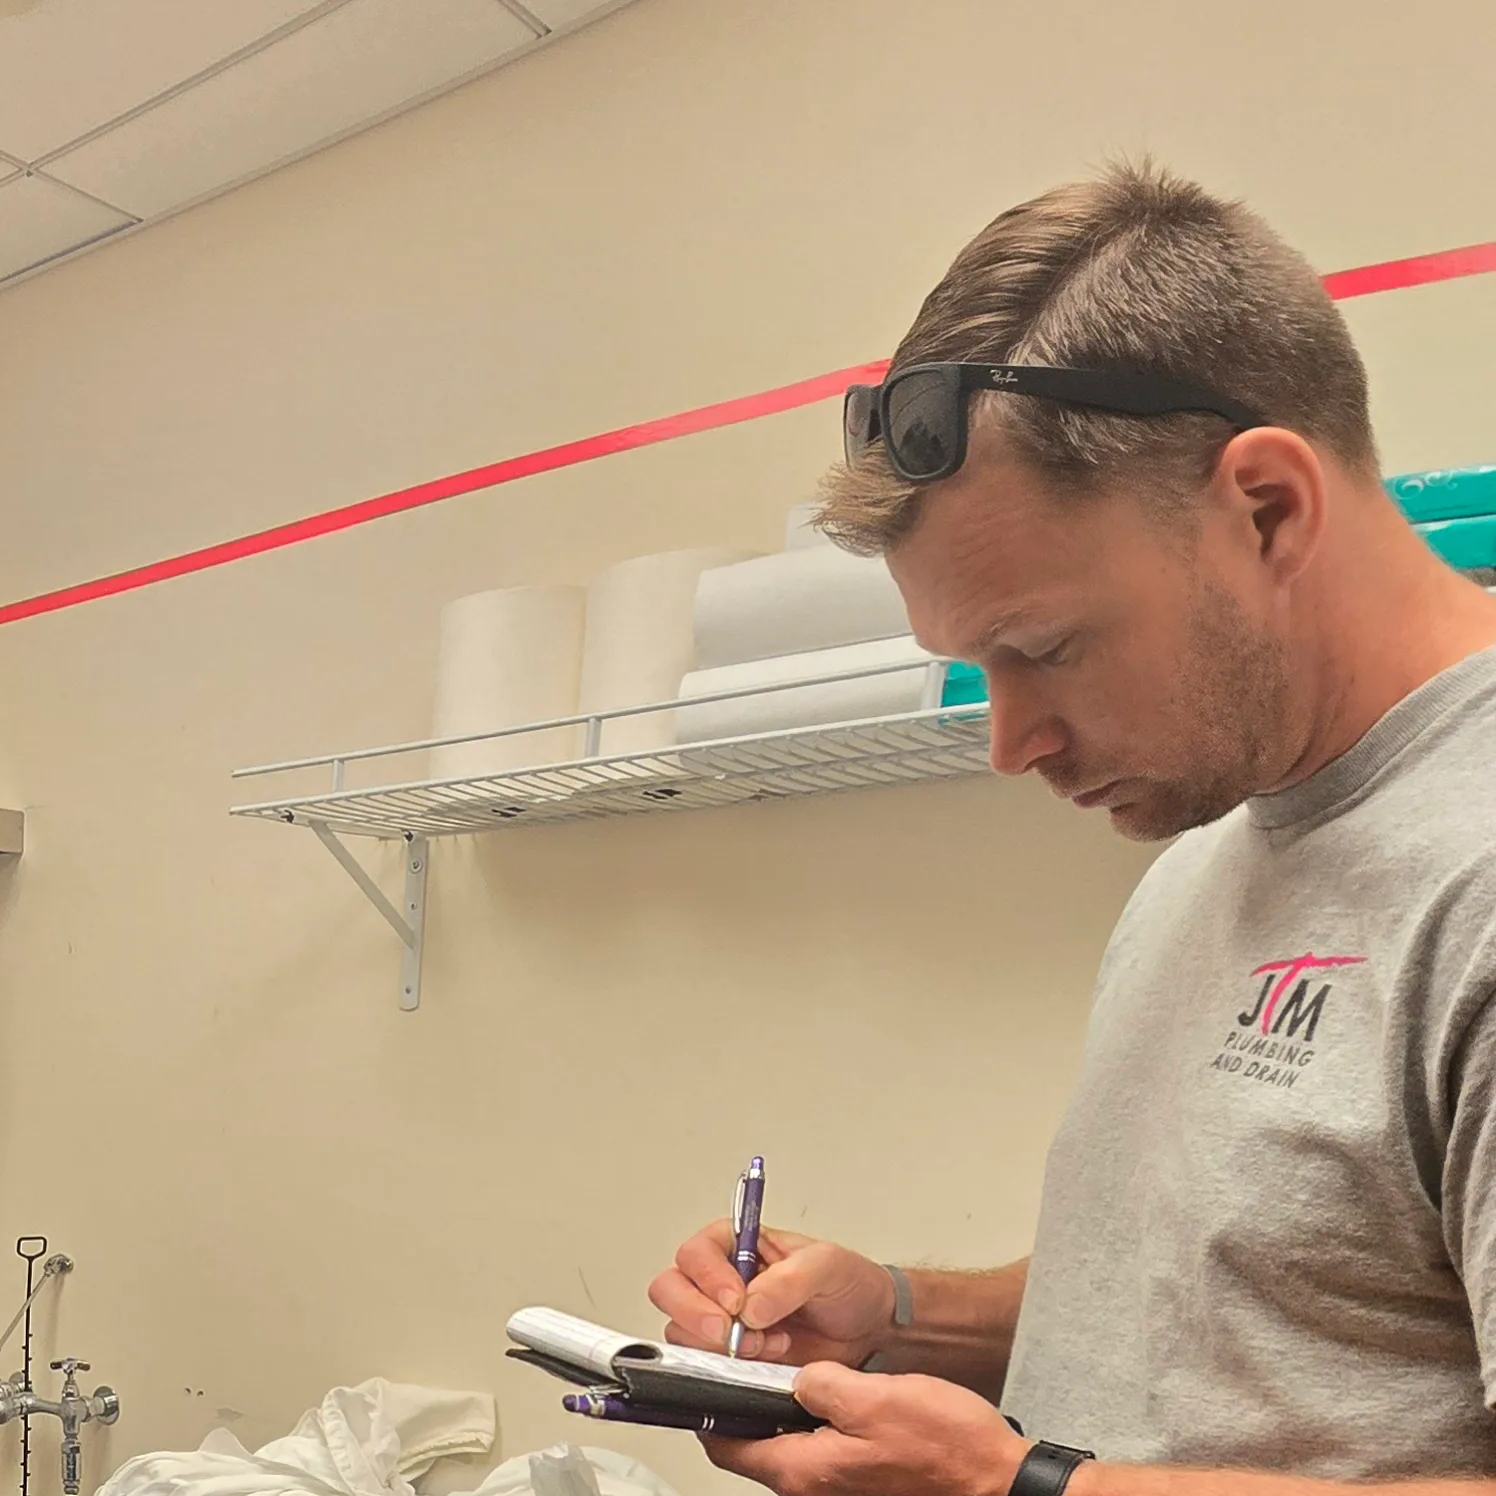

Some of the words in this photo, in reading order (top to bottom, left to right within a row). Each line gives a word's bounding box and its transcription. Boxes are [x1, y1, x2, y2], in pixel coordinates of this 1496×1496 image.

[1238, 952, 1368, 1042] JTM
[1223, 1031, 1315, 1067] PLUMBING
[1210, 1053, 1242, 1073] AND
[1243, 1061, 1300, 1088] DRAIN
